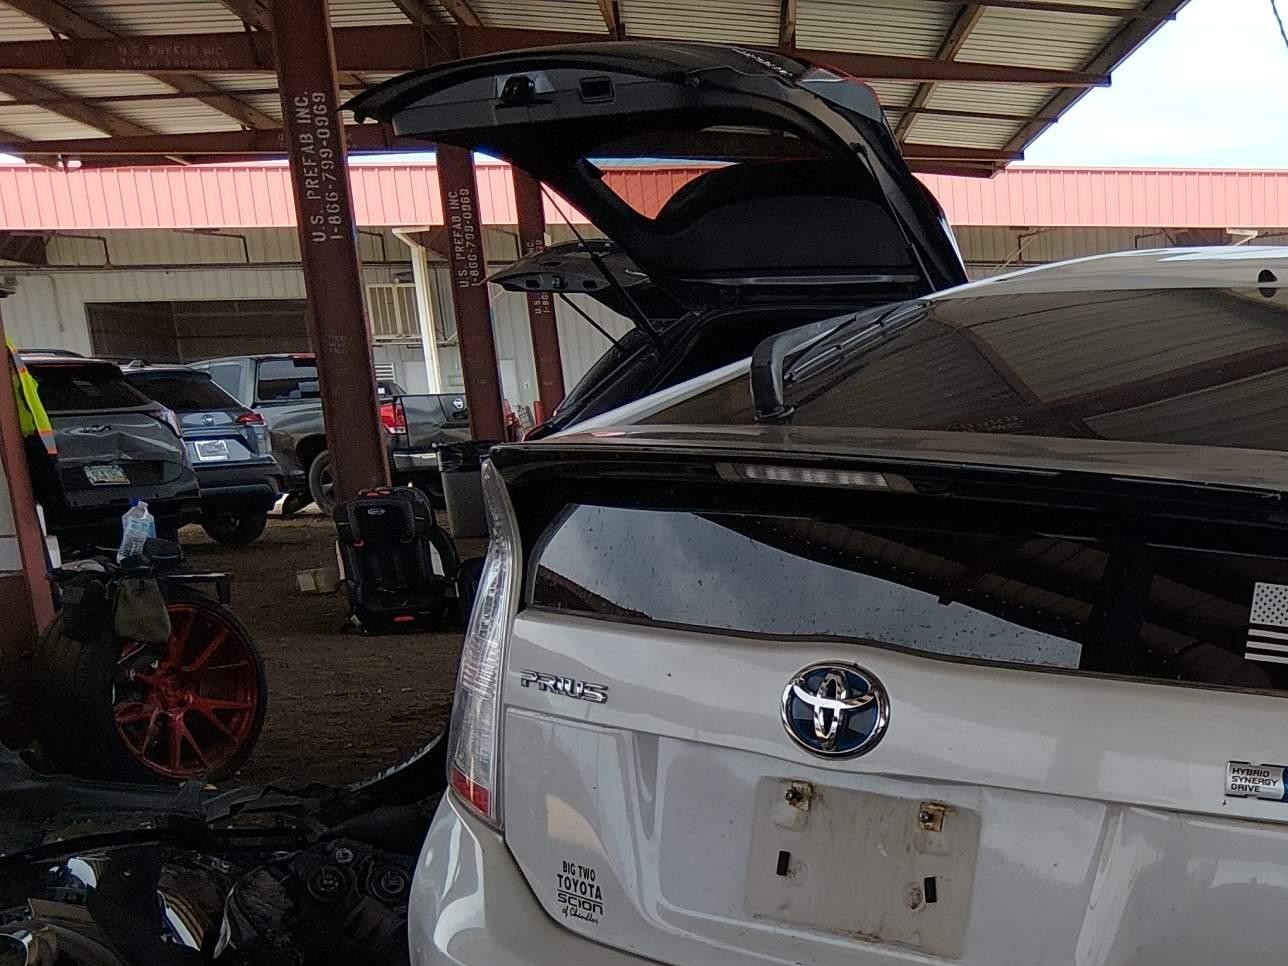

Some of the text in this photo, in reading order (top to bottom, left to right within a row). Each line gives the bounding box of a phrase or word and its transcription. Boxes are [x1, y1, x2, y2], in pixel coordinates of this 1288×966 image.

[294, 91, 327, 242] U.S. PREFAB INC.
[312, 92, 344, 240] 1-866-799-0969
[451, 216, 466, 260] PREFAB
[520, 669, 609, 704] PRIUS
[1231, 767, 1270, 778] HYBRID
[1231, 775, 1279, 786] SYNERGY
[1230, 783, 1261, 793] DRIVE
[562, 860, 596, 882] BIG TWO
[557, 873, 603, 900] TOYOTA
